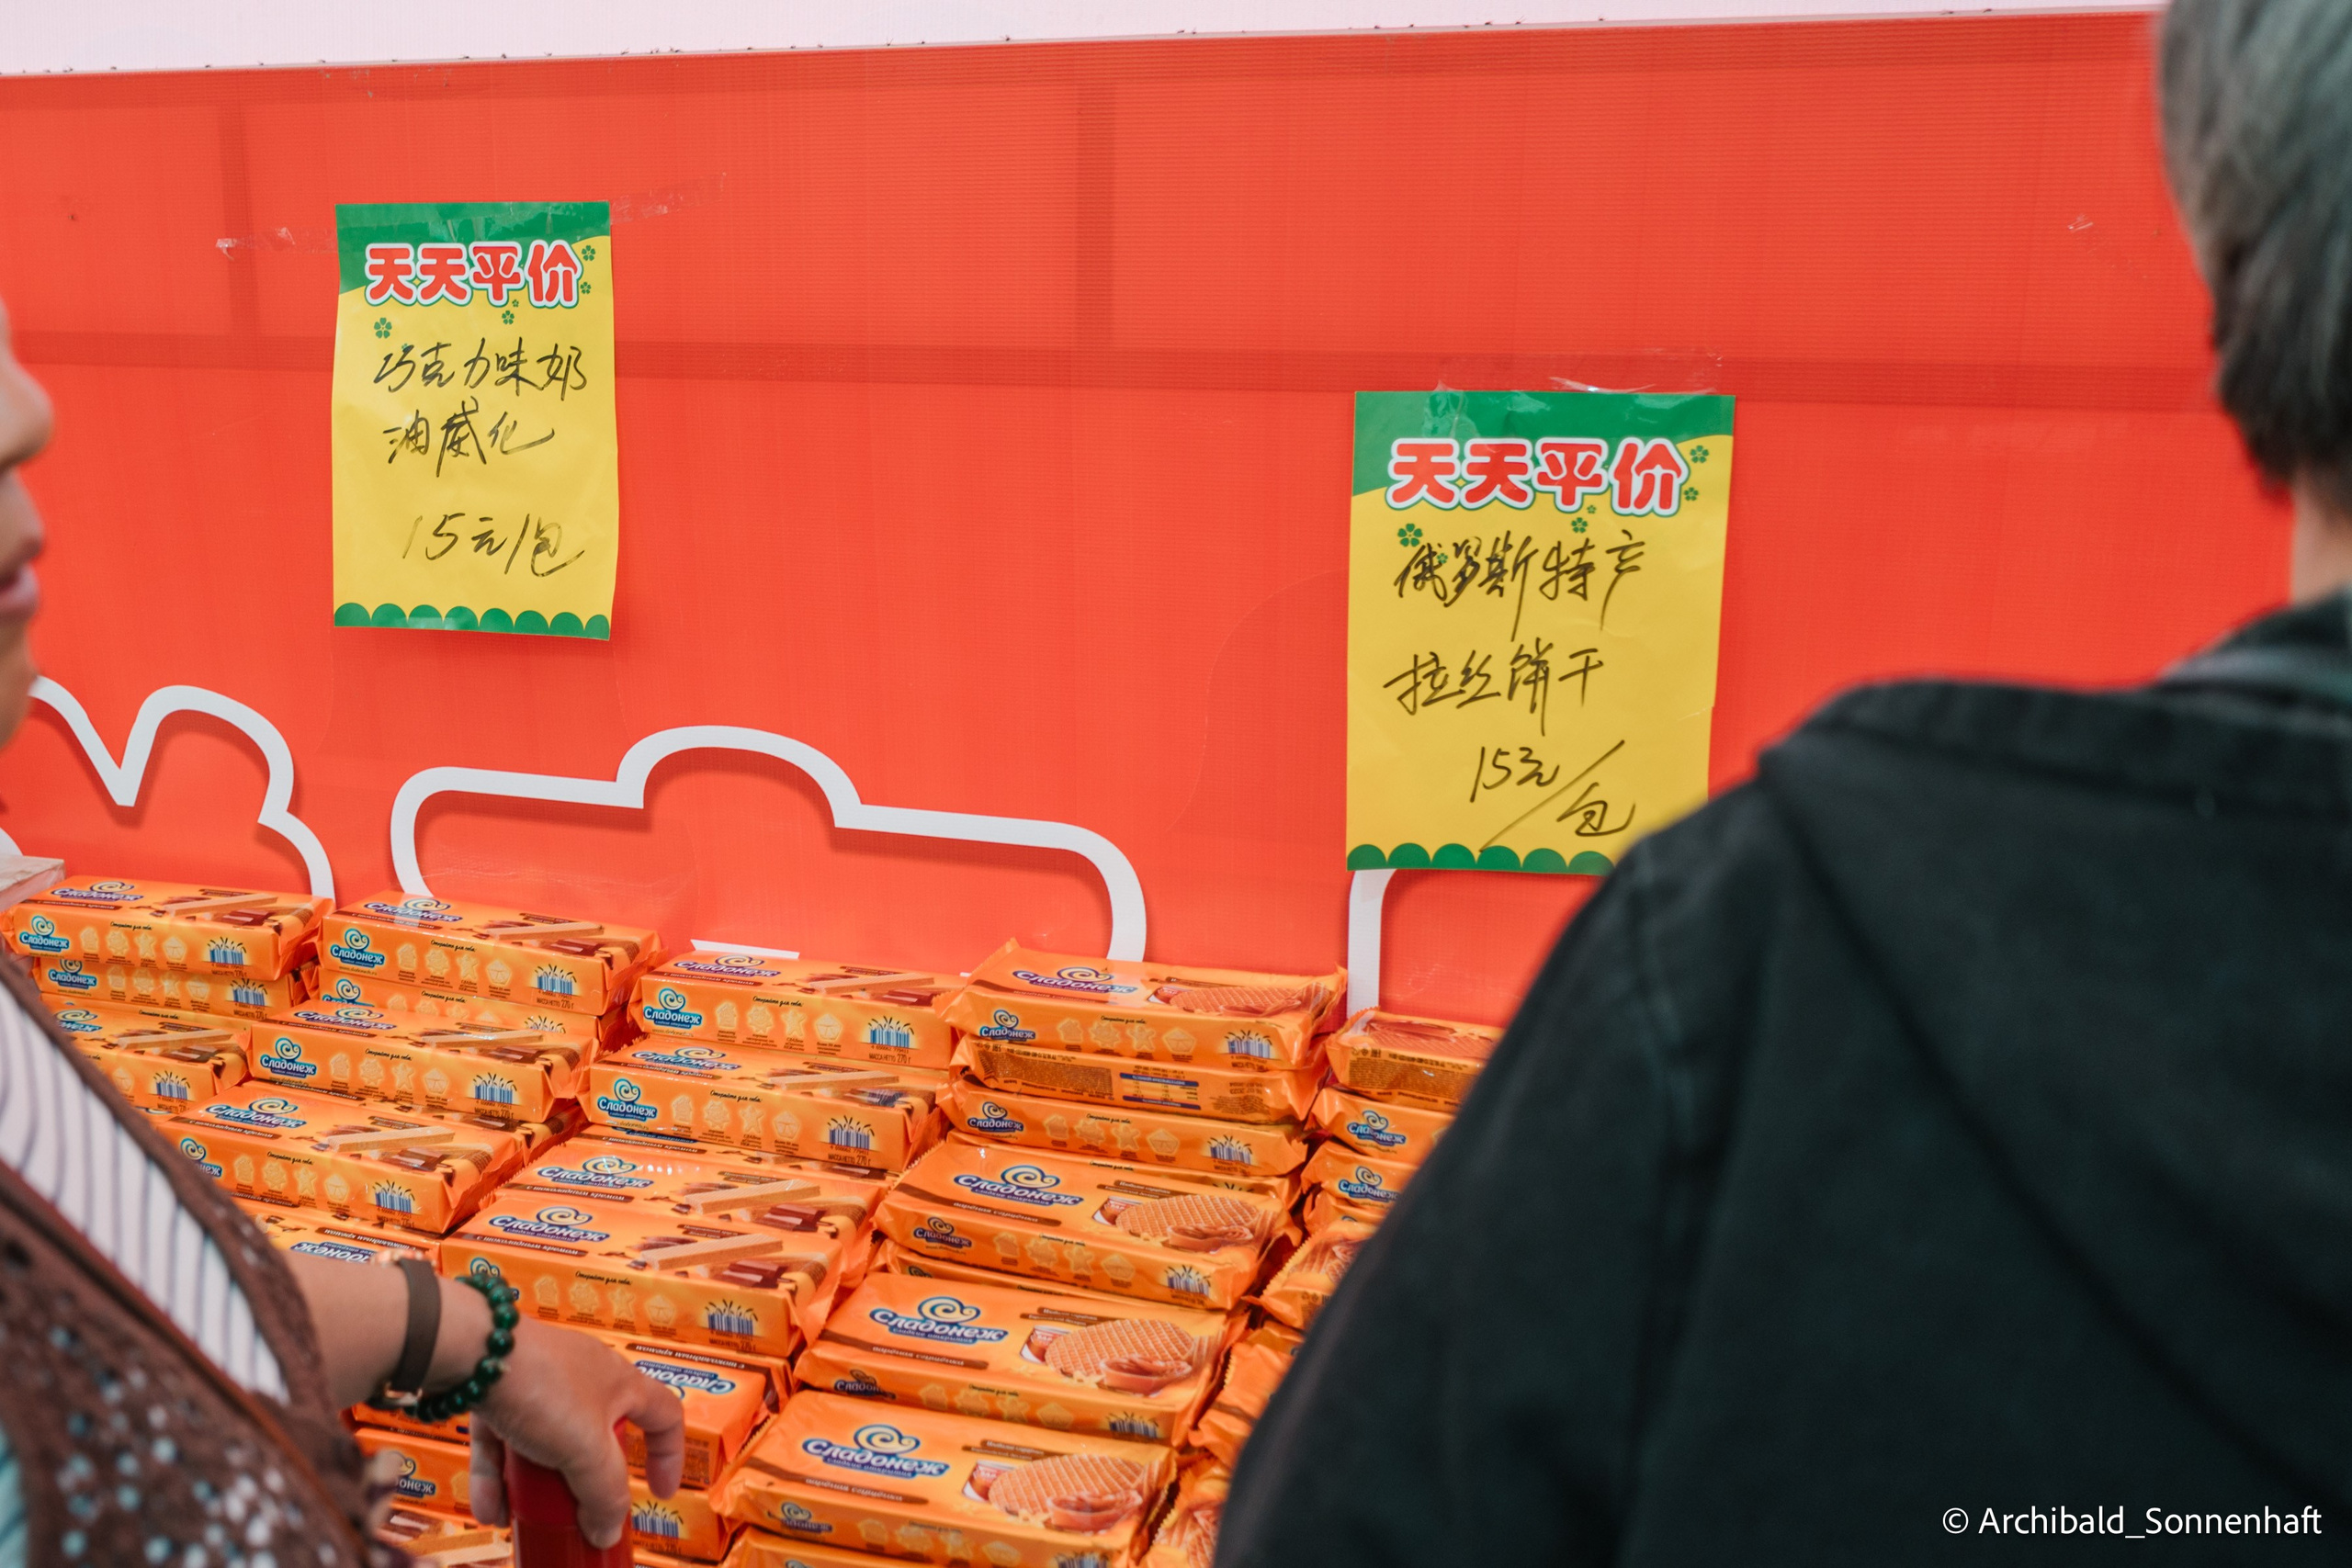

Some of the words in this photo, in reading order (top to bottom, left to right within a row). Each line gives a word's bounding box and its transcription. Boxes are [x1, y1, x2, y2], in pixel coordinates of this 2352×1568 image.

[367, 242, 581, 306] 天天平价
[373, 337, 587, 400] 巧克力味奶
[383, 396, 555, 478] 油威化
[1385, 438, 1688, 515] 天天平价
[402, 513, 585, 578] 15元/包
[1394, 529, 1645, 643] 俄罗斯特产
[1383, 637, 1604, 737] 拉丝饼干
[19, 932, 69, 949] Сладонеж
[332, 947, 384, 964] Сладонеж
[50, 971, 96, 986] Сладонеж
[677, 961, 779, 977] Сладонеж
[1015, 971, 1136, 992] Сладонеж
[645, 1007, 700, 1025] Сладонеж
[981, 1026, 1034, 1040] Сладонеж
[262, 1056, 315, 1074] Сладонеж
[635, 1052, 740, 1070] Сладонеж
[897, 1054, 907, 1064] 270
[209, 1105, 305, 1128] Сладонеж
[598, 1099, 657, 1117] Сладонеж
[969, 1118, 1023, 1132] Сладонеж
[1349, 1123, 1405, 1144] Сладонеж
[856, 1155, 866, 1166] 270
[539, 1168, 652, 1188] Сладонеж
[533, 1186, 588, 1196] шоколадным
[590, 1192, 625, 1201] кремом
[956, 1176, 1080, 1205] Сладонеж
[492, 1217, 608, 1241] Сладонеж
[915, 1228, 971, 1247] Сладонеж
[483, 1236, 541, 1249] шоколадным
[542, 1245, 579, 1255] кремом
[873, 1311, 1004, 1341] Сладонеж
[808, 1440, 946, 1476] Сладонеж
